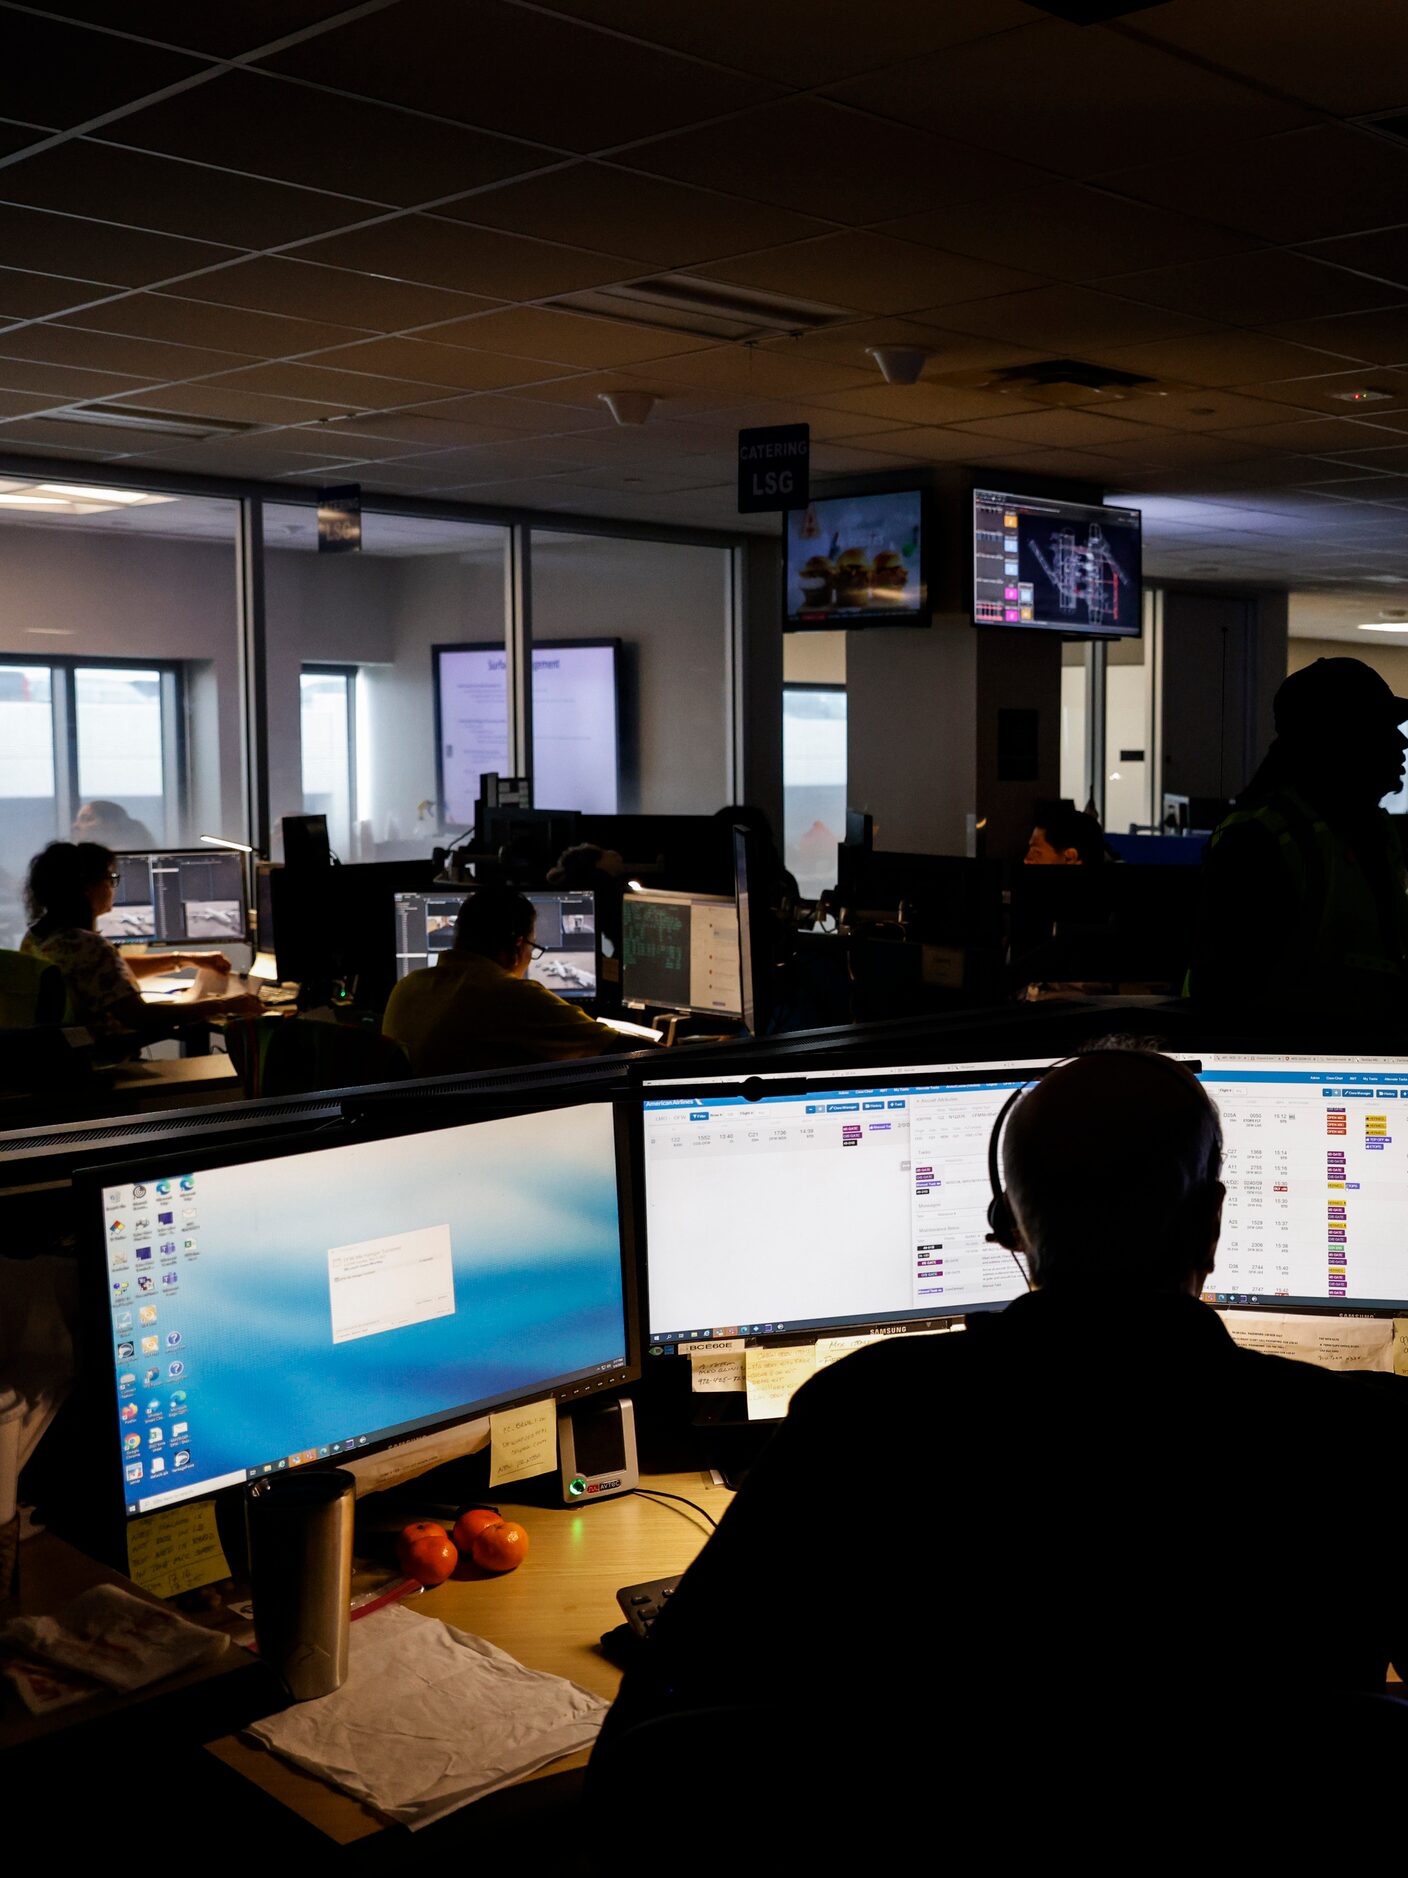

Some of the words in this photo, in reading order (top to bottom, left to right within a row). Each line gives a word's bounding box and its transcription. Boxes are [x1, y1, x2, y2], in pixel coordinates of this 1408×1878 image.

[740, 440, 808, 461] CATERING
[752, 470, 793, 496] LSG
[488, 660, 507, 671] Surfa
[532, 659, 561, 671] gement
[870, 1326, 907, 1335] SAMSUNG
